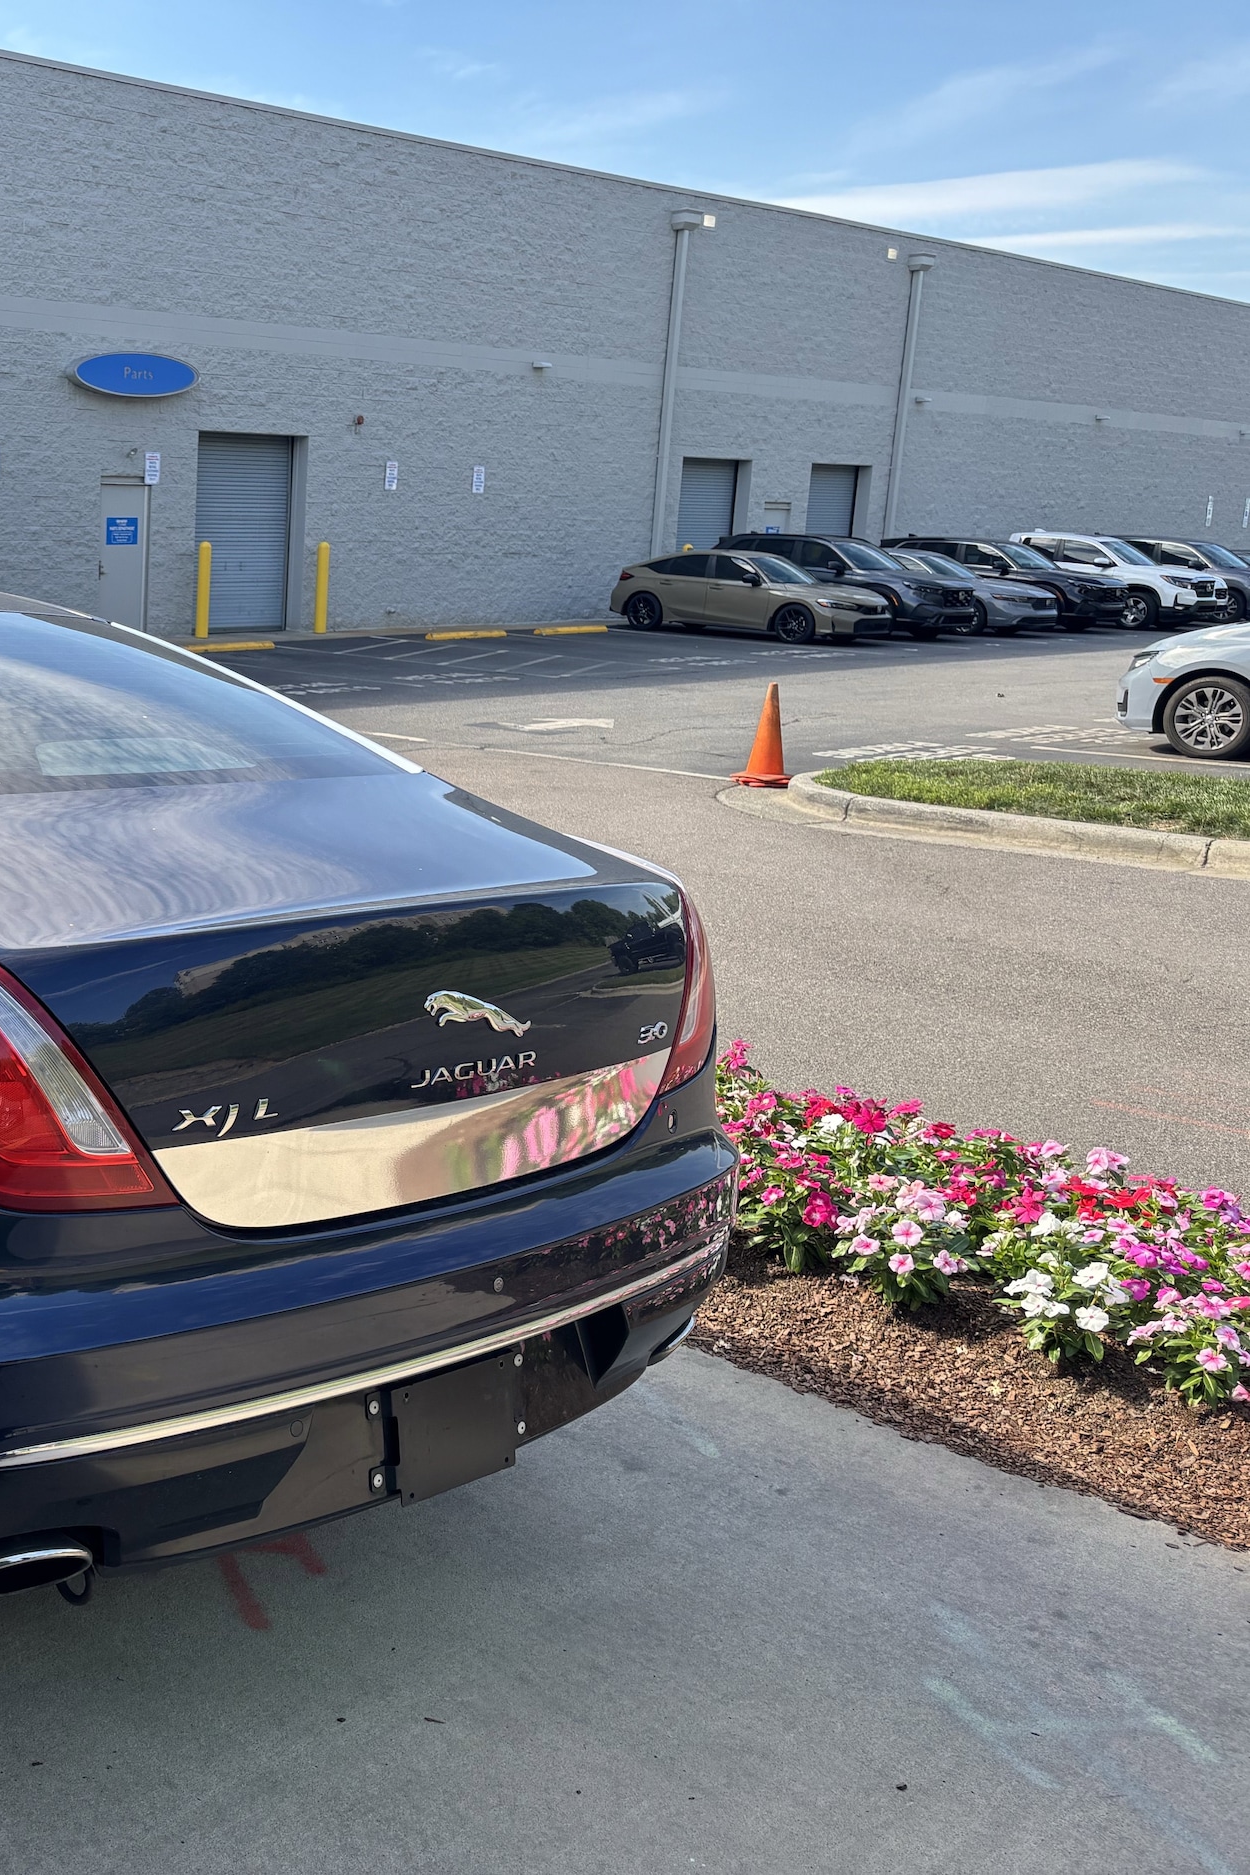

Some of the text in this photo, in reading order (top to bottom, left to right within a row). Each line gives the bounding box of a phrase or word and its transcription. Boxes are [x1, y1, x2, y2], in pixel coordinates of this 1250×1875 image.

[123, 366, 153, 379] Parts
[410, 1050, 537, 1088] JAGUAR
[171, 1098, 278, 1137] XJ L
